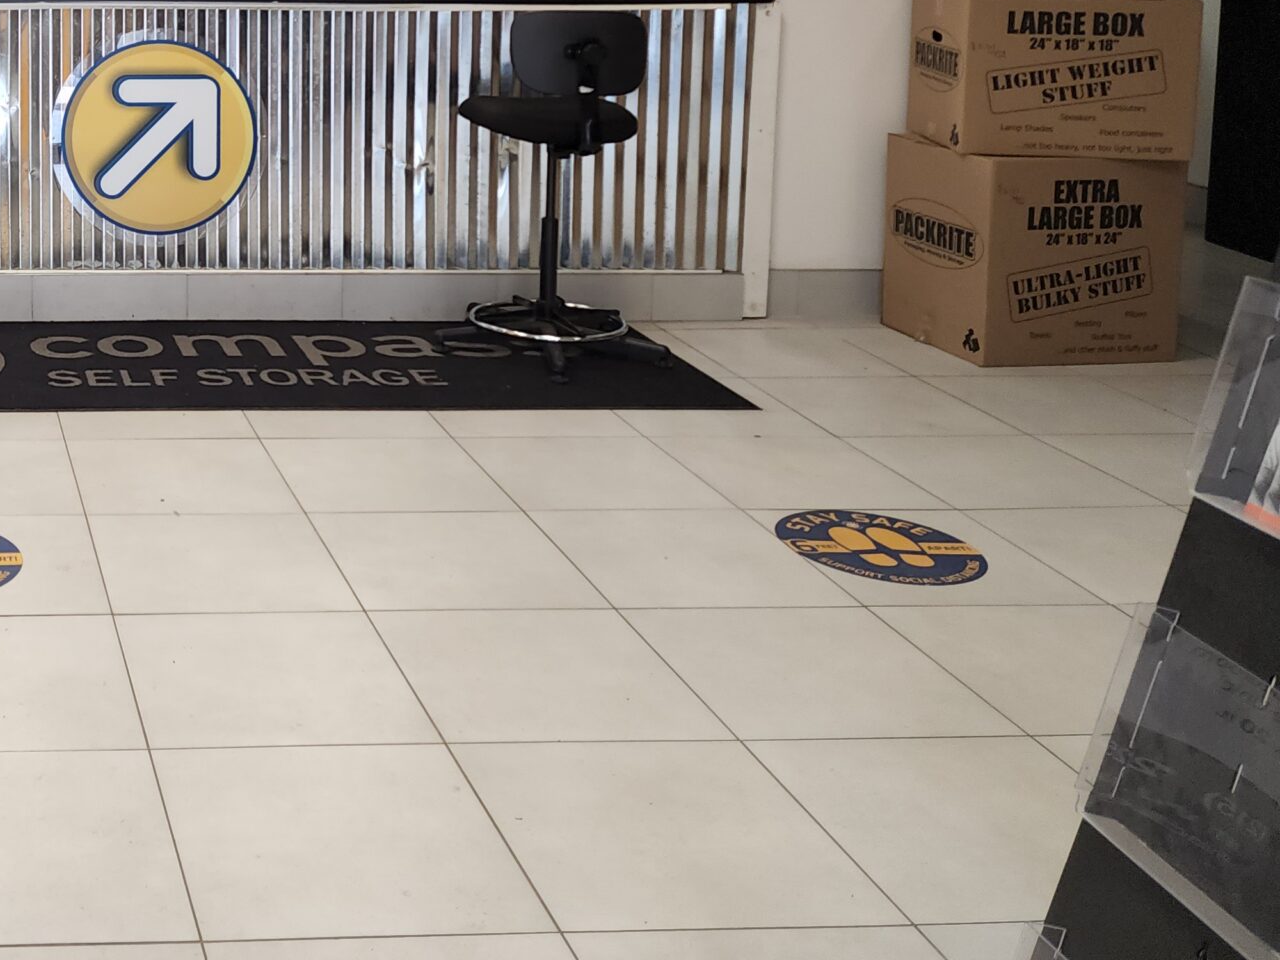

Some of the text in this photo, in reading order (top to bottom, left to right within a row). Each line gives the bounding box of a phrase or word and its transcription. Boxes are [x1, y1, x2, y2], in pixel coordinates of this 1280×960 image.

[1006, 10, 1145, 38] LARGE BOX
[1029, 37, 1120, 52] 24" x 18" x 18"
[915, 41, 959, 77] PACKRITE
[991, 55, 1160, 91] LIGHT WEIGHT
[1041, 80, 1113, 104] STUFF
[1054, 178, 1120, 204] EXTRA
[1027, 204, 1143, 231] LARGE BOX
[894, 208, 974, 258] PACKRITE
[1046, 231, 1123, 246] 24" x 18" x 24"
[1012, 255, 1142, 296] ULTRA-LIGHT
[1017, 272, 1147, 315] BULKY STUFF
[29, 335, 542, 366] compas
[46, 368, 449, 387] SELF STORAGE
[786, 512, 935, 537] STAY SAFE
[791, 539, 819, 553] 6
[819, 556, 884, 579] SUPPORT
[888, 575, 943, 584] SOCIAL
